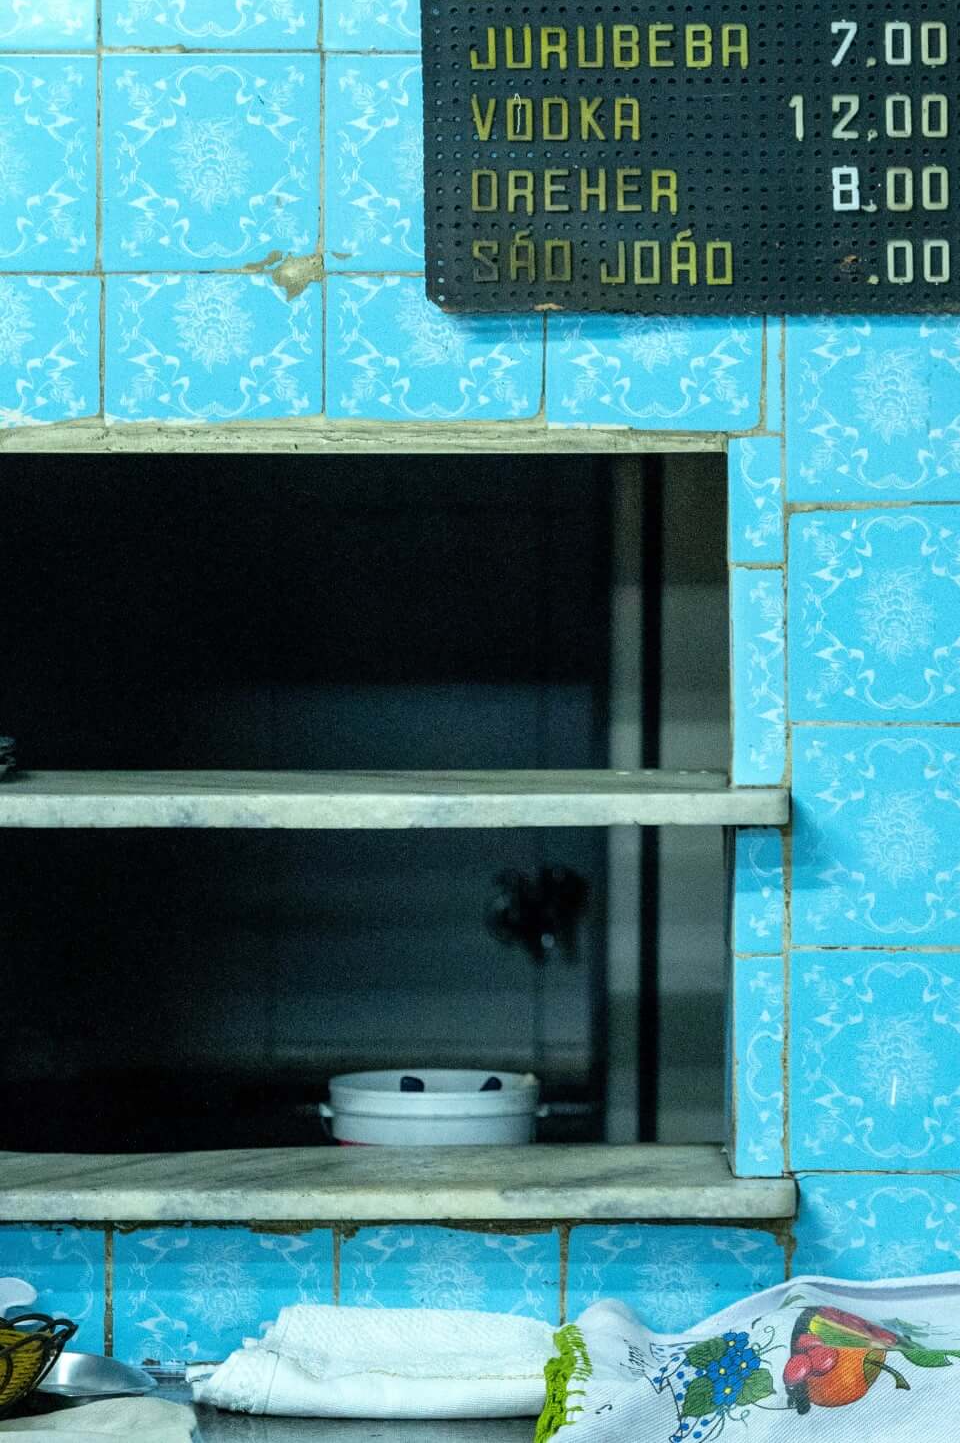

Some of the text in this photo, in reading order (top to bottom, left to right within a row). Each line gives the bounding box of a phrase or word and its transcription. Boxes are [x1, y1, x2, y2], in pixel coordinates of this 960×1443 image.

[471, 22, 748, 69] JURUBEBA
[472, 93, 639, 140] VODKA
[472, 169, 677, 215] DREHER
